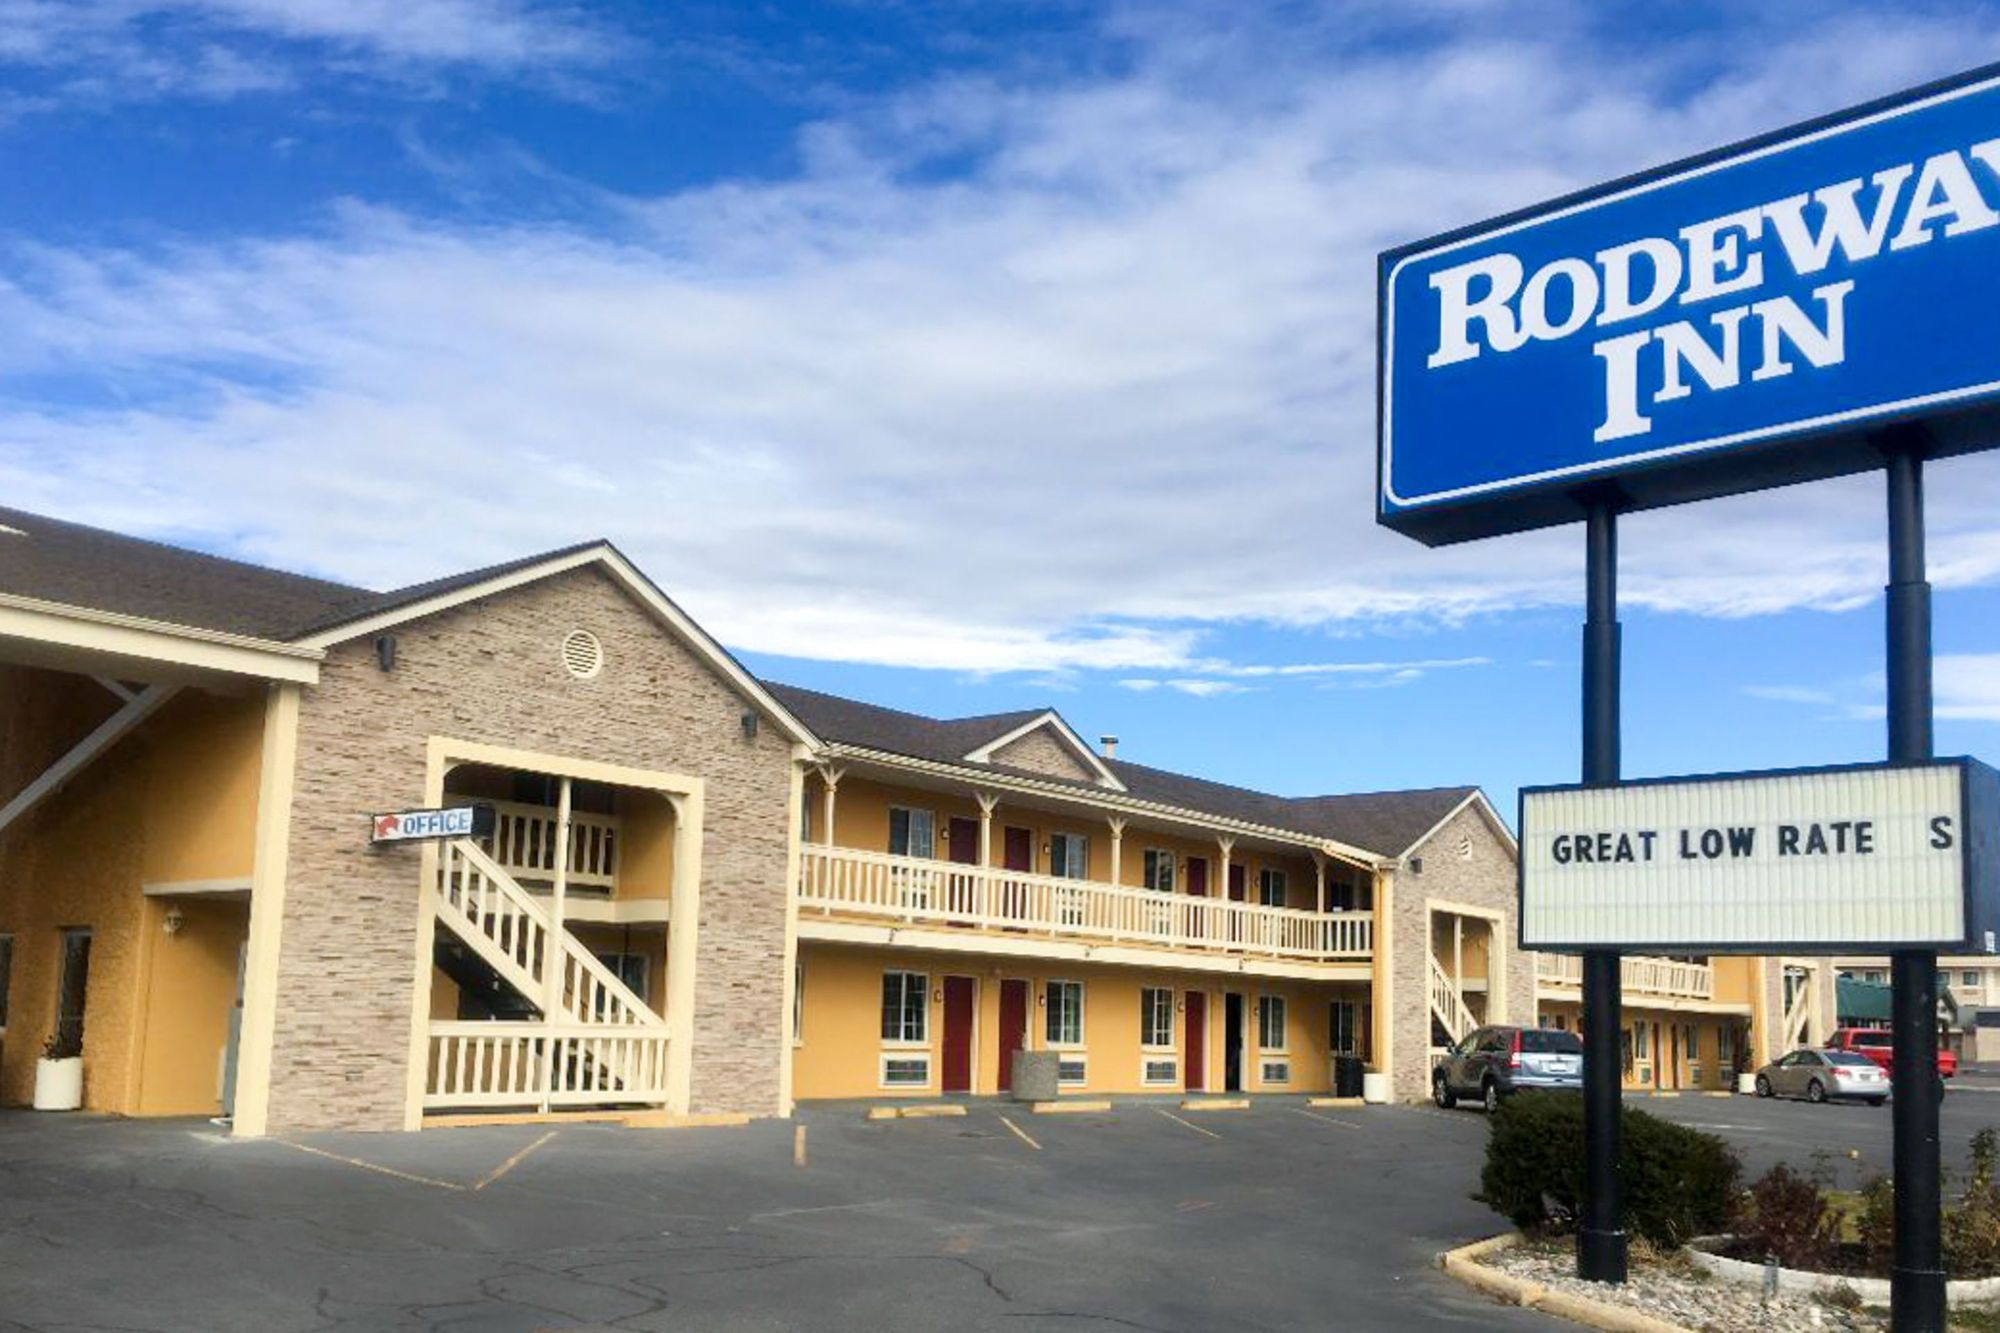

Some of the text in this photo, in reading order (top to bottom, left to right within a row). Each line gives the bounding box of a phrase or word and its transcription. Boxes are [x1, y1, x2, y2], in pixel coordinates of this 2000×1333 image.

[1593, 280, 1855, 443] INN
[404, 812, 468, 834] OFFICE
[1552, 815, 1953, 864] GREAT LOW RATE S
